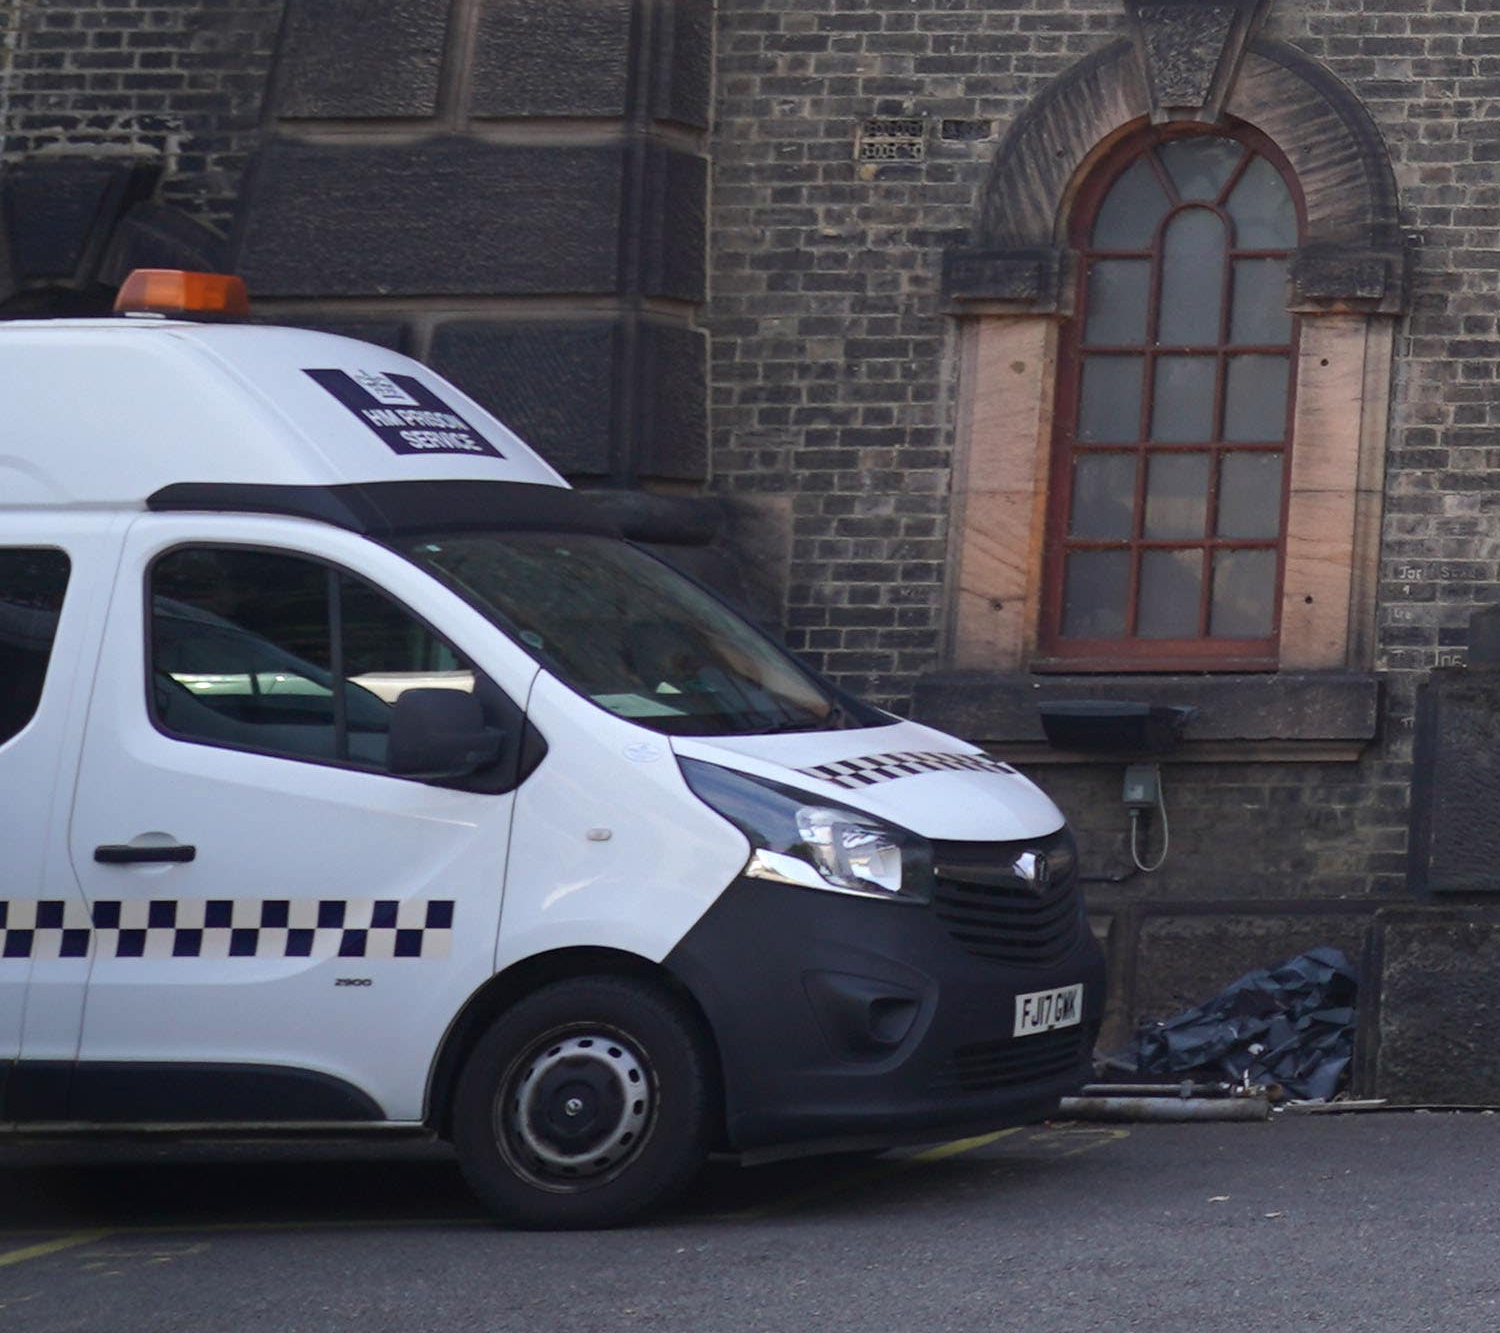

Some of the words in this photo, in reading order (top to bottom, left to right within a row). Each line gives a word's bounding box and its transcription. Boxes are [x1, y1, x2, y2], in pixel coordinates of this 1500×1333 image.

[361, 409, 404, 427] HM
[396, 409, 471, 431] PRISON
[400, 430, 483, 451] SERVICE
[1022, 994, 1052, 1029] FJ17
